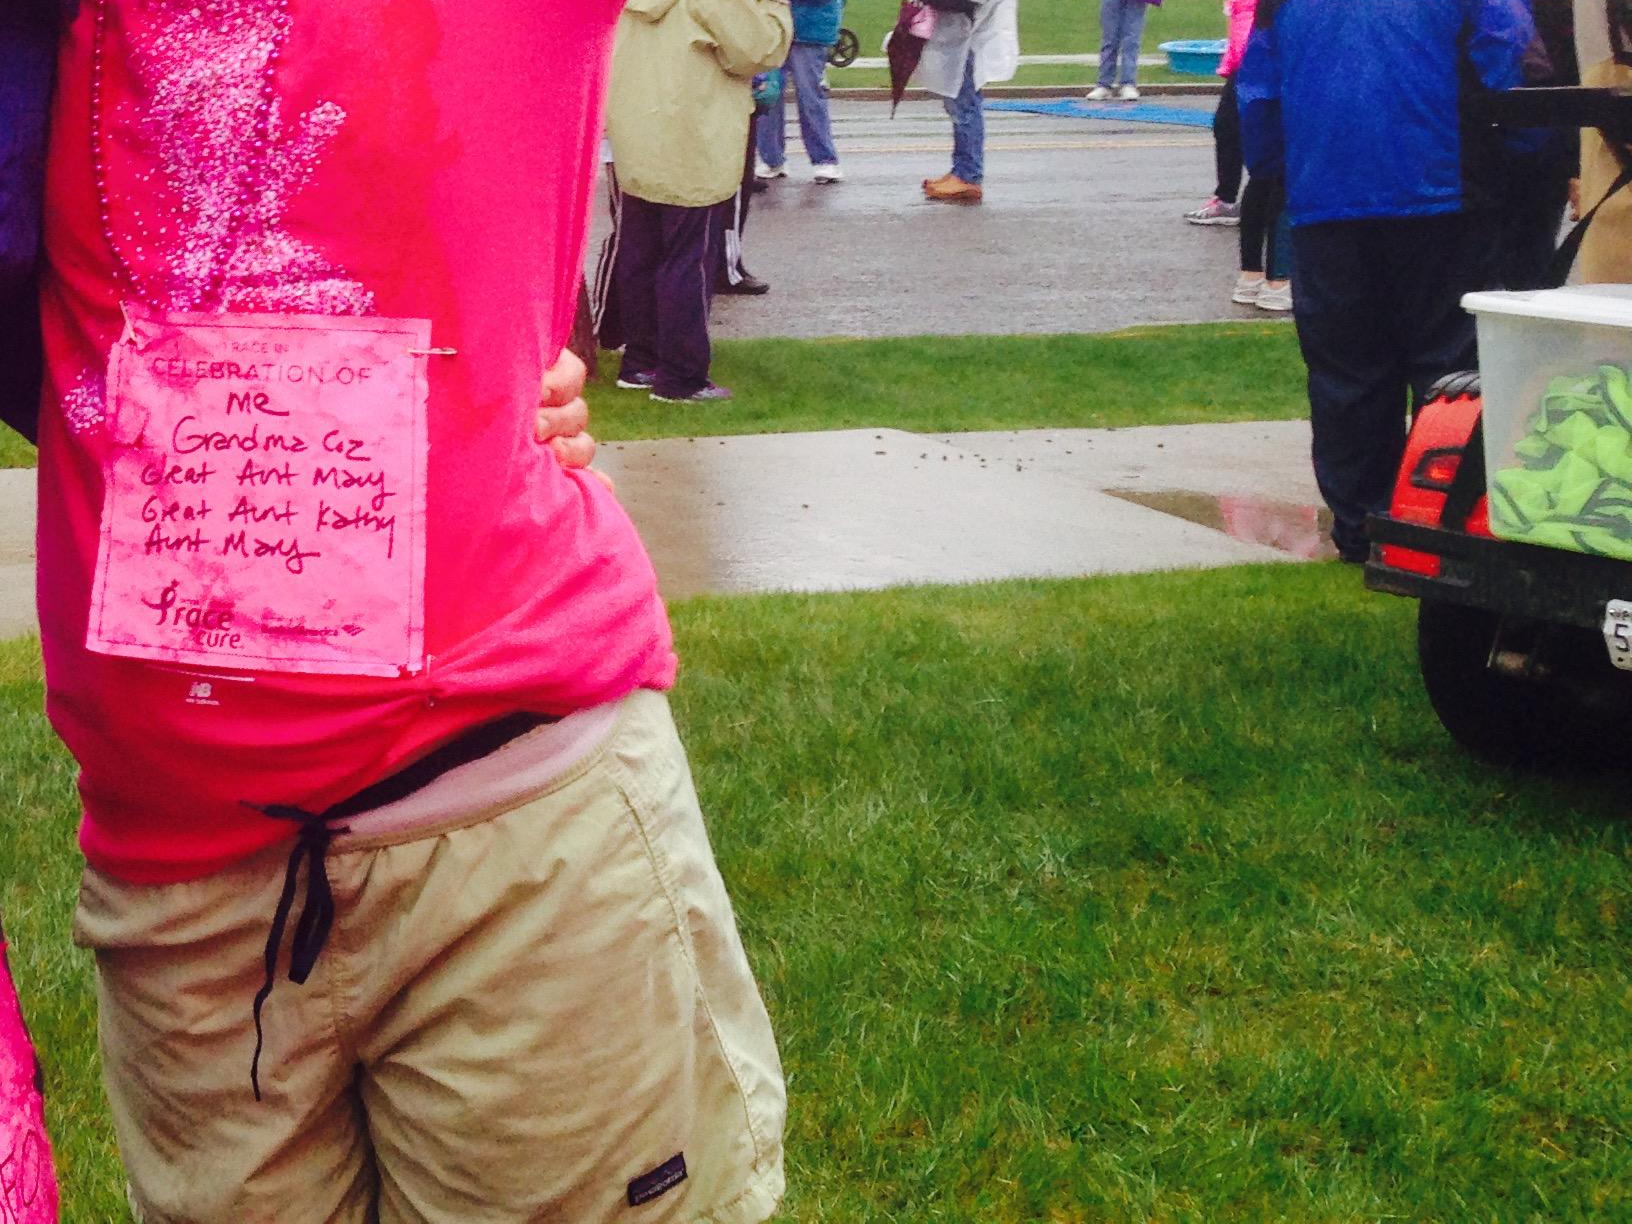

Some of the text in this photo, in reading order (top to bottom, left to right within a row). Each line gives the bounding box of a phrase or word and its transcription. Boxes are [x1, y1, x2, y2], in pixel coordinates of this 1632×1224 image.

[152, 356, 373, 385] CELEBRATION OF
[172, 415, 308, 454] Grandma
[140, 461, 216, 486] Great
[312, 466, 397, 512] Mary
[141, 495, 396, 559] Great Aunt Kathy
[144, 523, 322, 575] Aunt Mary
[172, 606, 235, 632] race
[192, 629, 241, 649] cure
